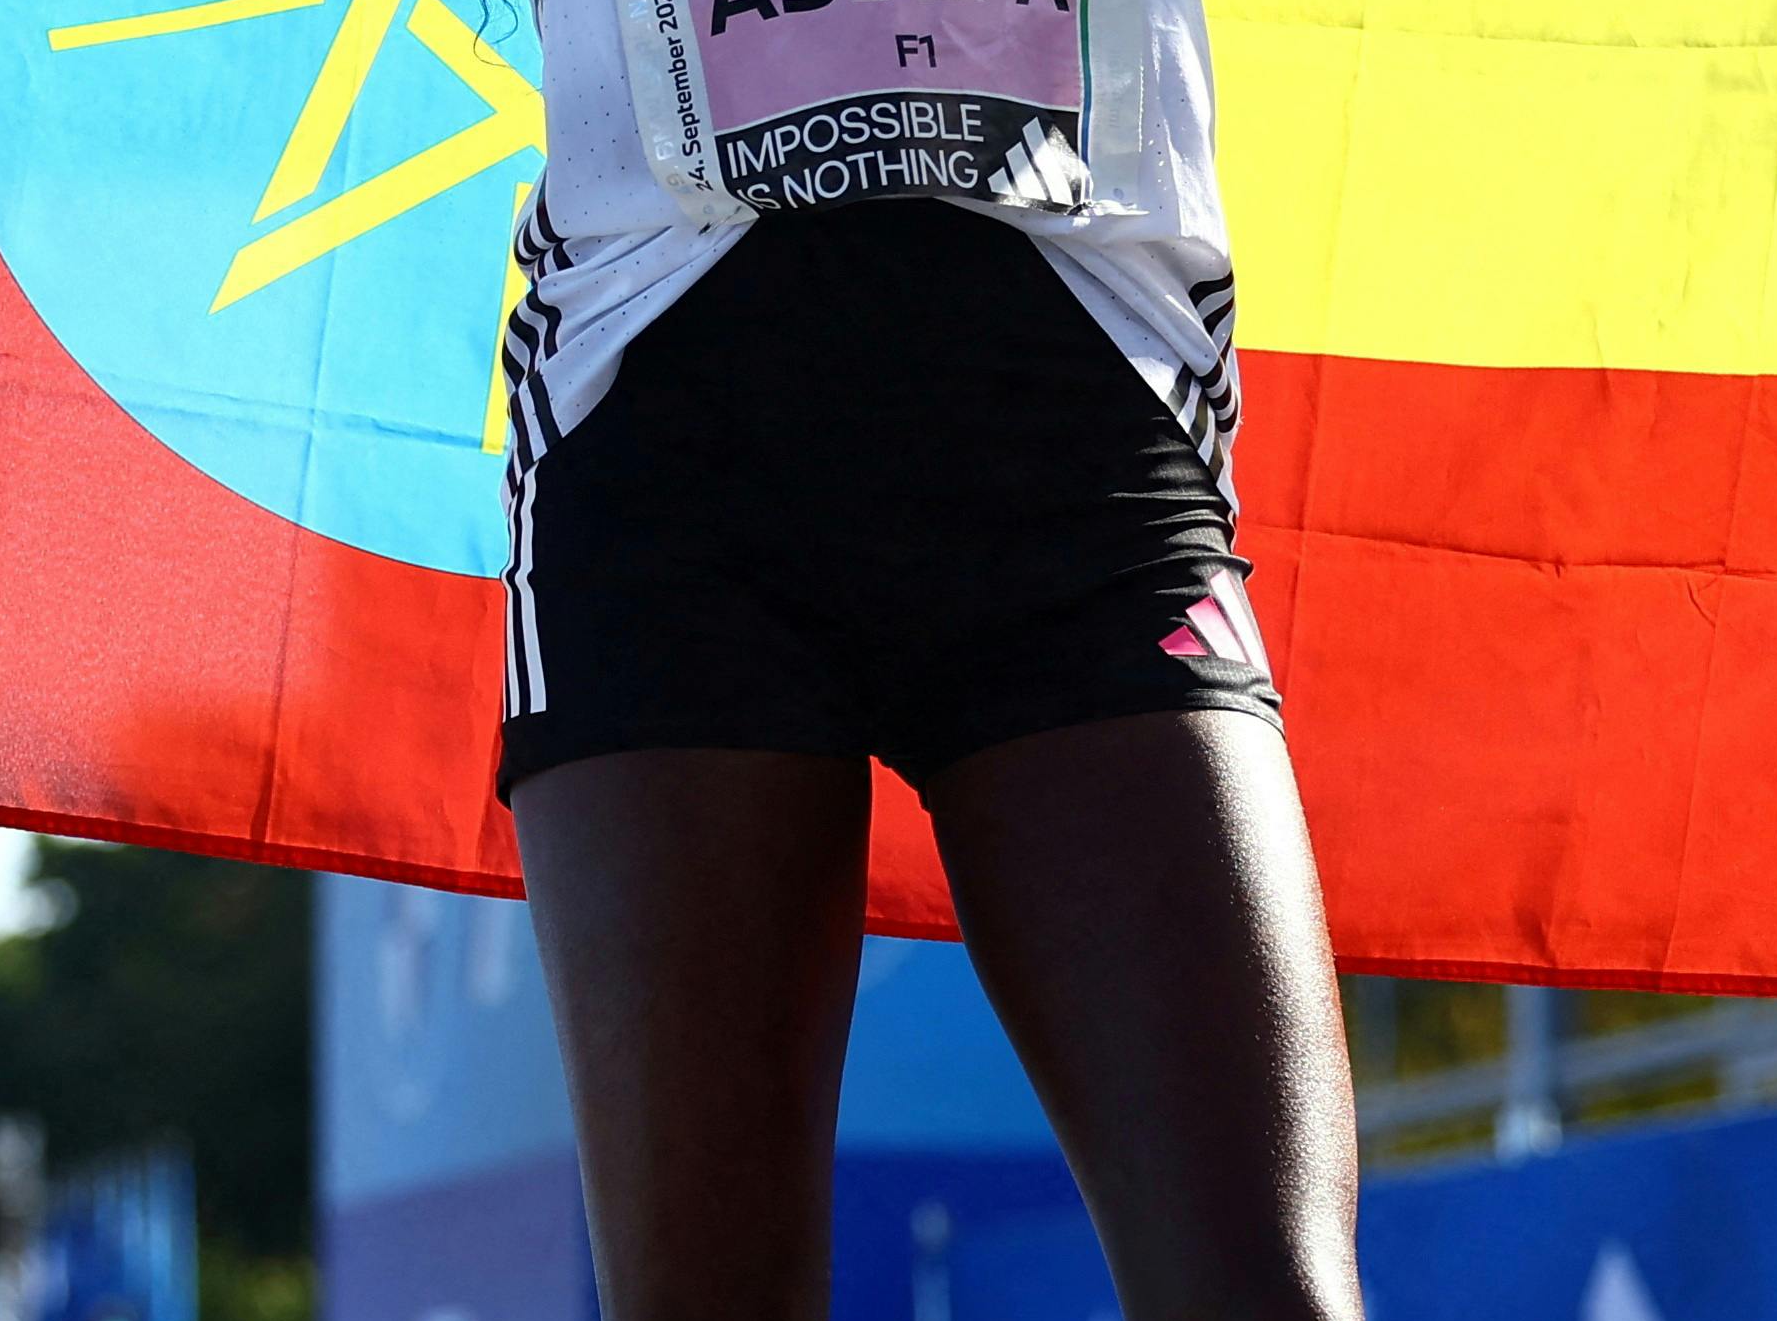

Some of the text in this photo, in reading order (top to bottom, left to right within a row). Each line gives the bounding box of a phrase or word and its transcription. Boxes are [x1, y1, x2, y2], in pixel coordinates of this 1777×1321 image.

[895, 34, 937, 68] F1
[668, 37, 702, 157] September
[726, 101, 984, 178] IMPOSSIBLE
[688, 160, 714, 191] 24.
[737, 149, 979, 210] IS NOTHING
